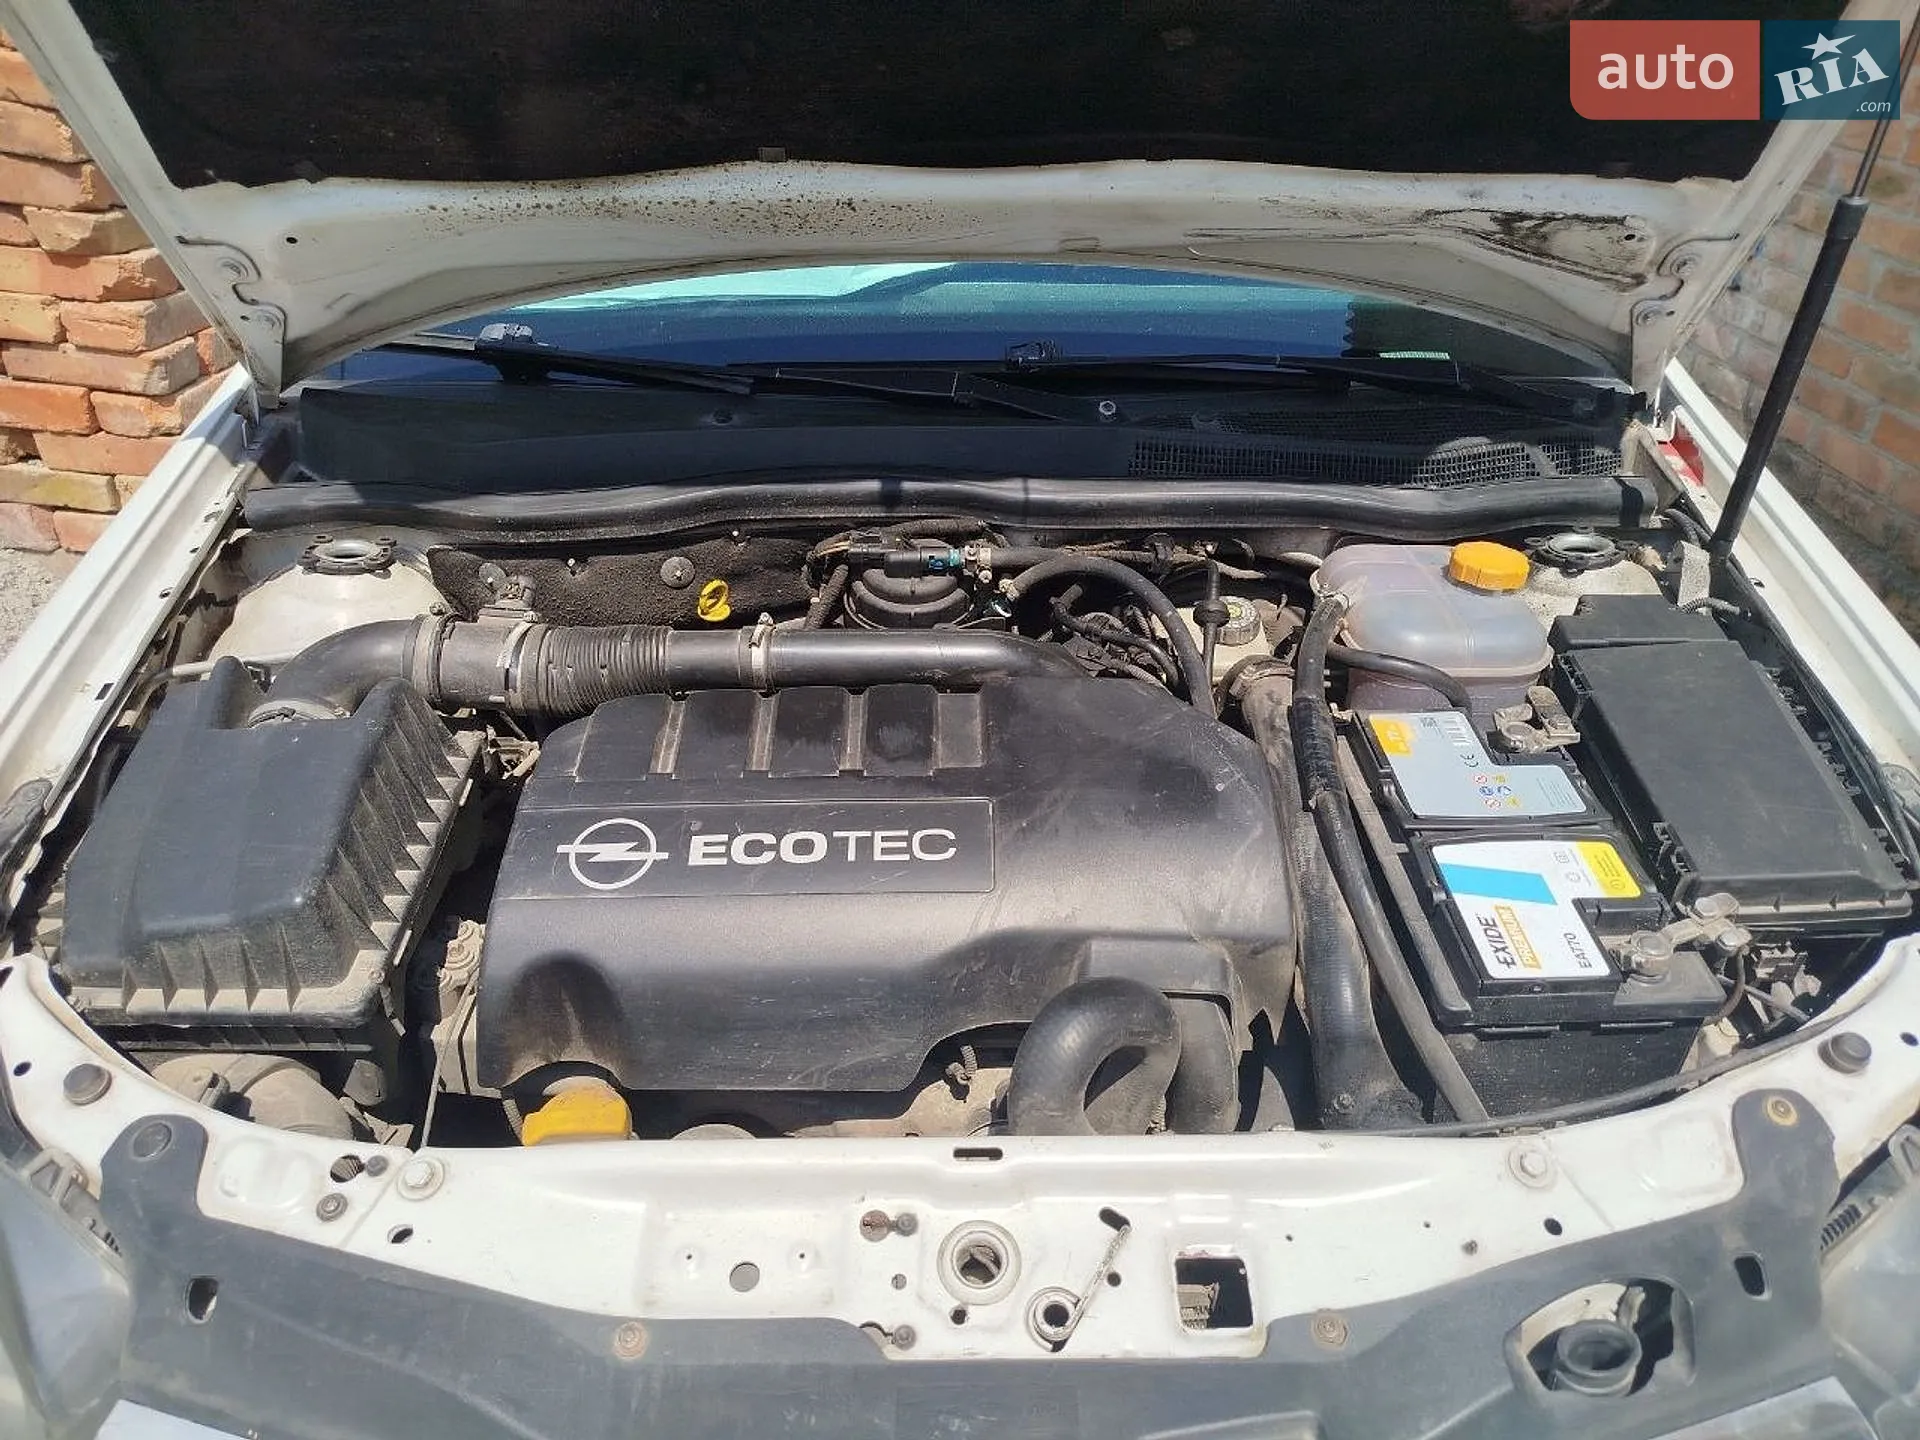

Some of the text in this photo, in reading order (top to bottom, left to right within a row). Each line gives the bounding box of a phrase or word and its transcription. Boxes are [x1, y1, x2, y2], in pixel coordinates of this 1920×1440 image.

[688, 828, 957, 866] ECOTEC
[1477, 914, 1517, 969] EXIDE
[1563, 932, 1593, 969] EA770
